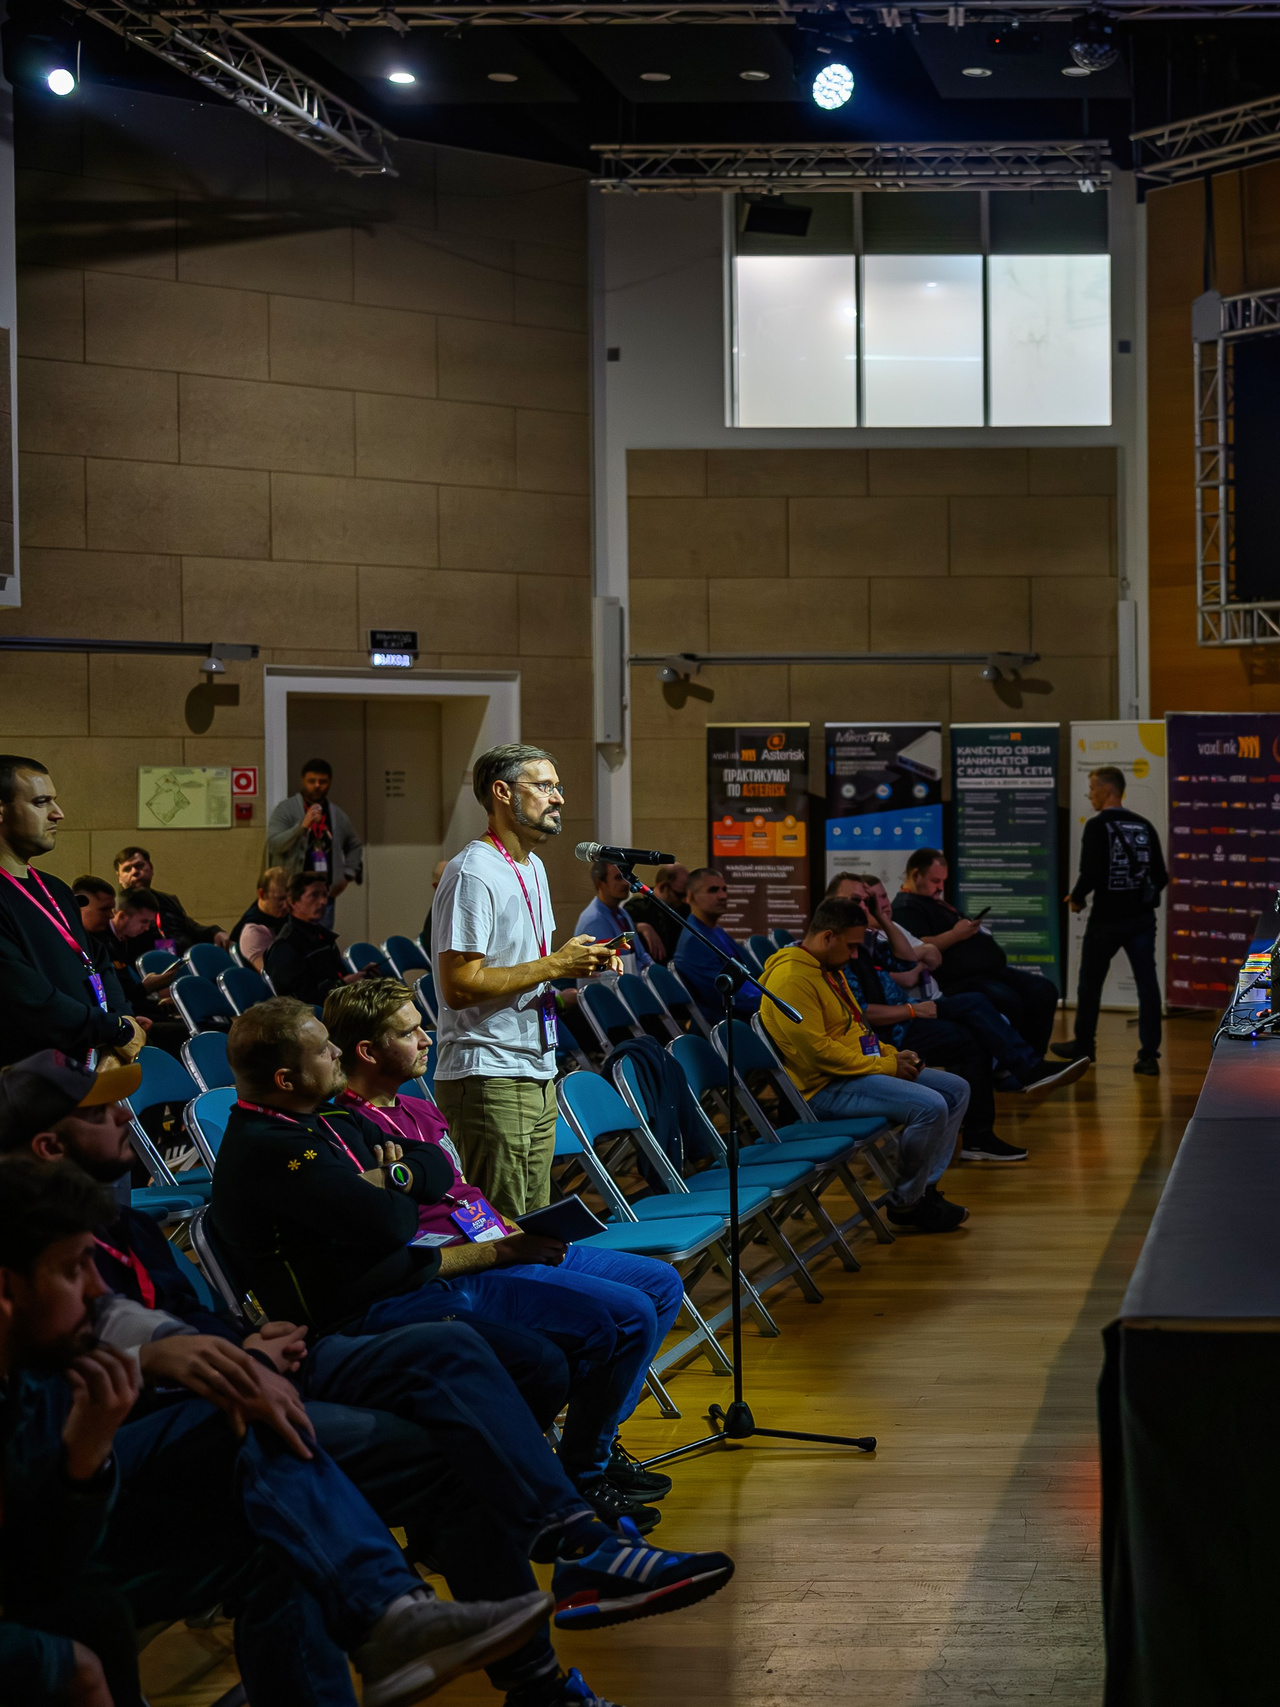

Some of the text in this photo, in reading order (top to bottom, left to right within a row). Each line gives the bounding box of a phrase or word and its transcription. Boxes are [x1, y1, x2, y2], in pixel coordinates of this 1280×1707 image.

[373, 653, 410, 667] ВЫХОД
[836, 731, 891, 743] MikroTik
[761, 749, 805, 760] Asterisk
[957, 746, 1050, 755] КАЧЕСТВО СВЯЗИ
[957, 756, 1029, 765] НАЧИНАЕТСЯ
[723, 768, 790, 782] ПРАКТИКУМЫ
[957, 767, 1052, 776] С КАЧЕСТВА СЕТИ
[727, 783, 786, 797] ПО ASTERISK
